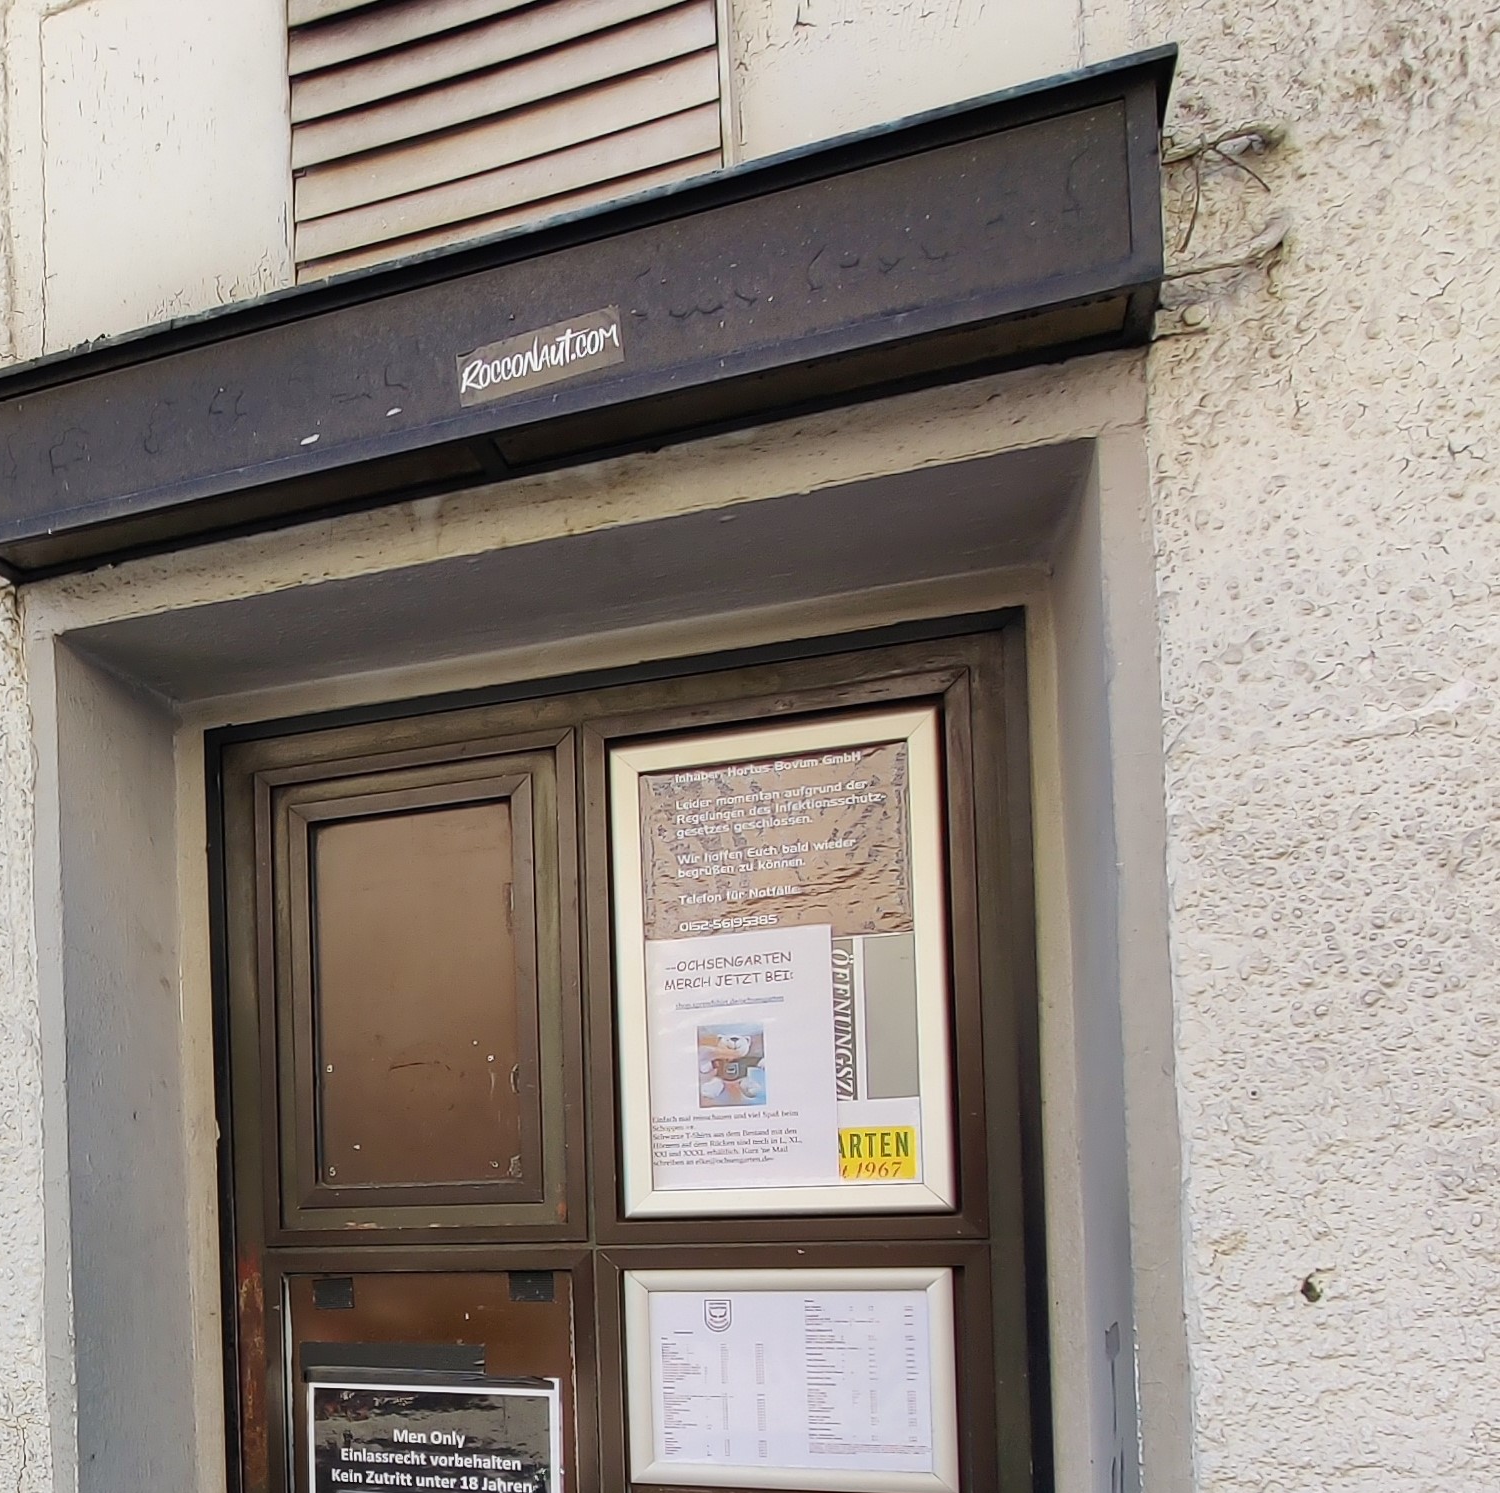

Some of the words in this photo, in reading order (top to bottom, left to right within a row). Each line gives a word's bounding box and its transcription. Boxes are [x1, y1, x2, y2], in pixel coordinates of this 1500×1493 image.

[822, 751, 862, 765] GmbH
[676, 797, 712, 811] Leider
[716, 790, 780, 807] momentan
[784, 781, 842, 799] aufgrund
[846, 779, 869, 791] der
[676, 808, 744, 826] Regelungen
[749, 805, 771, 816] des
[676, 823, 730, 840] gesetzes
[734, 815, 813, 833] geschlossen.
[678, 853, 700, 865] Wir
[704, 849, 743, 864] hoffen
[782, 842, 809, 855] bald
[813, 837, 856, 851] wieder
[739, 862, 754, 872] zu
[758, 857, 806, 871] können.
[679, 893, 722, 906] Telefon
[726, 888, 746, 901] für
[664, 976, 711, 990] MERCH
[715, 972, 761, 987] JETZT
[393, 1429, 427, 1444] Men
[430, 1430, 466, 1449] Only
[340, 1448, 427, 1466] Einlassrecht
[429, 1452, 522, 1471] vorbehalten
[331, 1468, 363, 1484] Kein
[365, 1470, 413, 1487] Zutritt
[416, 1474, 457, 1490] unter
[460, 1476, 479, 1491] 18
